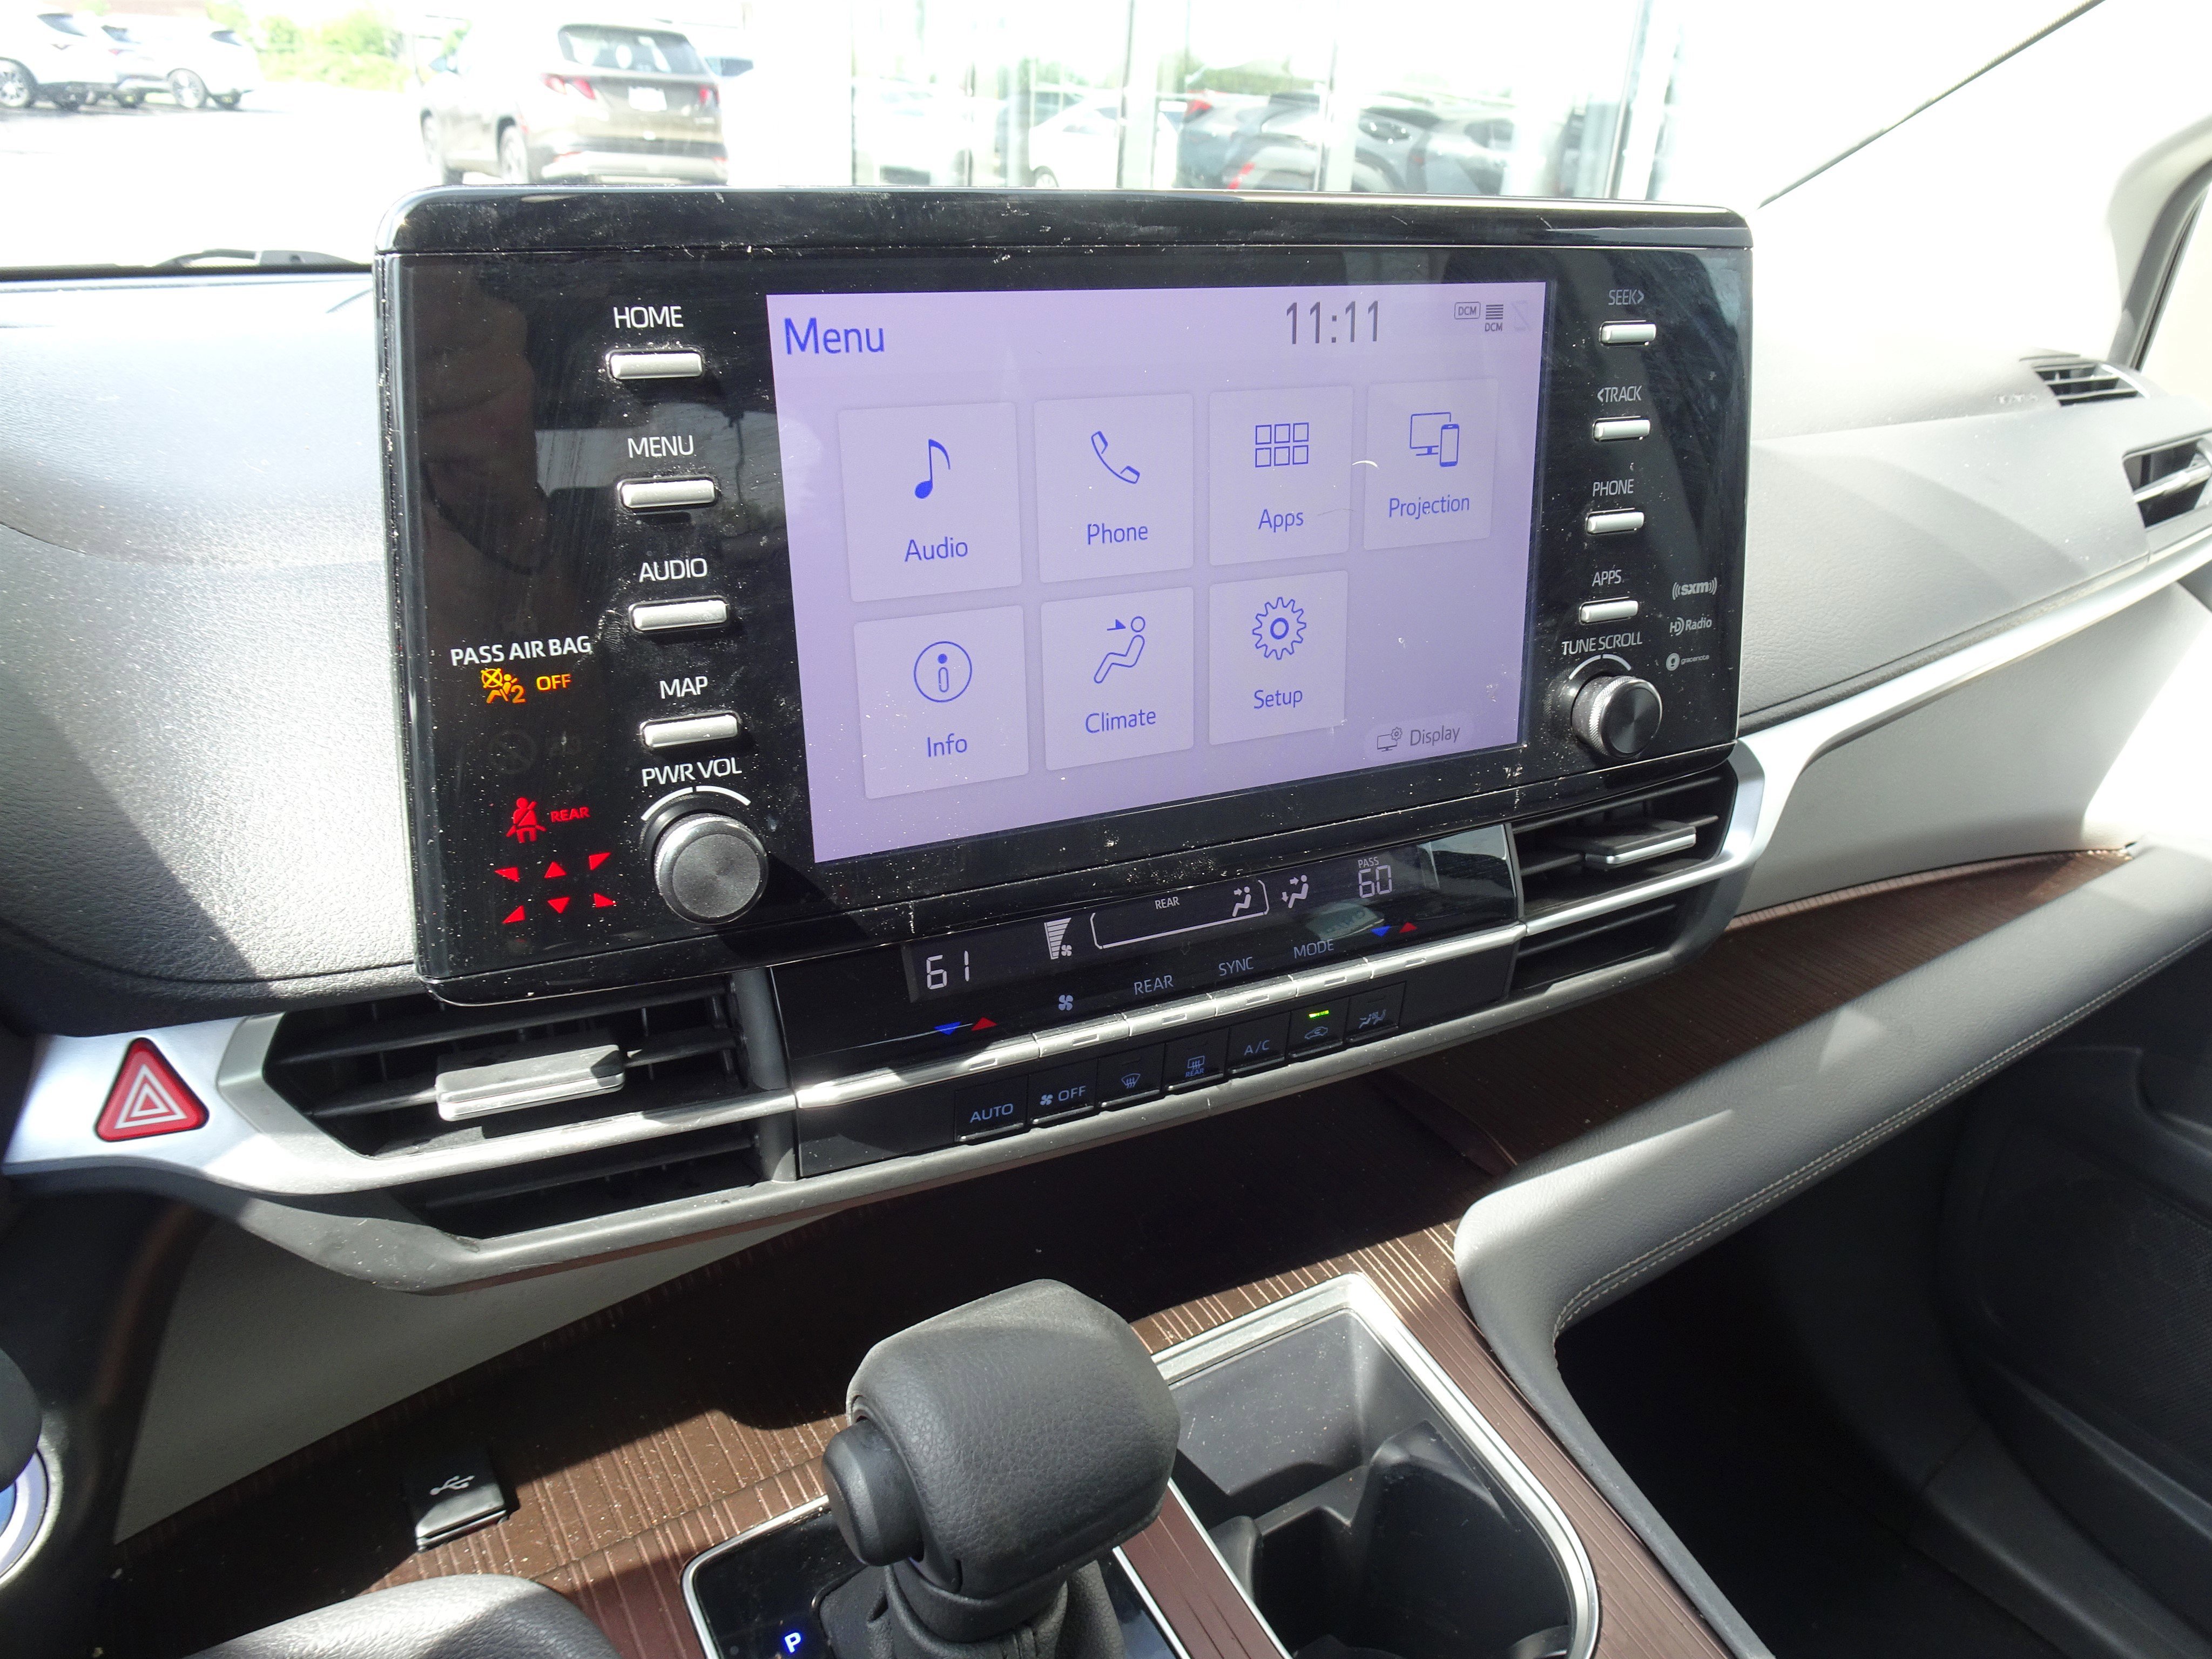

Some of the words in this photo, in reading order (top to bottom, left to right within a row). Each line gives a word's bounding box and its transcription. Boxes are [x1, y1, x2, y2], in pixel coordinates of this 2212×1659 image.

[613, 306, 684, 328] HOME
[1458, 306, 1477, 315] DCM
[1286, 300, 1379, 345] 11:11
[1485, 322, 1503, 332] DCM
[784, 317, 885, 355] Menu
[628, 435, 694, 458] MENU
[1592, 478, 1635, 497] PHONE
[1389, 494, 1470, 520] Projection
[1258, 508, 1304, 533] Apps
[1087, 522, 1149, 545] Phone
[904, 536, 969, 562] Audio
[638, 558, 708, 583] AUDIO
[1592, 569, 1622, 587] APPS
[1685, 617, 1712, 631] Radio
[450, 644, 505, 666] PASS
[509, 640, 547, 660] AIR
[548, 635, 591, 656] BAG
[1562, 637, 1596, 656] TUNE
[1598, 631, 1643, 650] SCROLL
[1680, 654, 1710, 665] gracenote
[536, 673, 571, 691] OFF
[659, 676, 708, 699] MAP
[1253, 689, 1303, 710] Setup
[1085, 709, 1156, 734] Climate
[927, 733, 967, 757] Info
[1410, 725, 1460, 747] Display
[642, 763, 696, 787] PWR
[697, 757, 743, 779] VOL
[550, 806, 591, 823] REAR
[1357, 856, 1379, 869] PASS
[1358, 865, 1392, 899] 60
[1155, 896, 1180, 910] REAR
[1293, 939, 1334, 959] MODE
[926, 950, 970, 990] 61
[1218, 956, 1254, 976] SYNC
[1134, 974, 1175, 995] REAR
[1244, 1040, 1270, 1056] A/C
[1185, 1068, 1205, 1078] REAR
[1057, 1085, 1087, 1102] OFF
[969, 1103, 1014, 1123] AUTO
[784, 1631, 802, 1654] P
